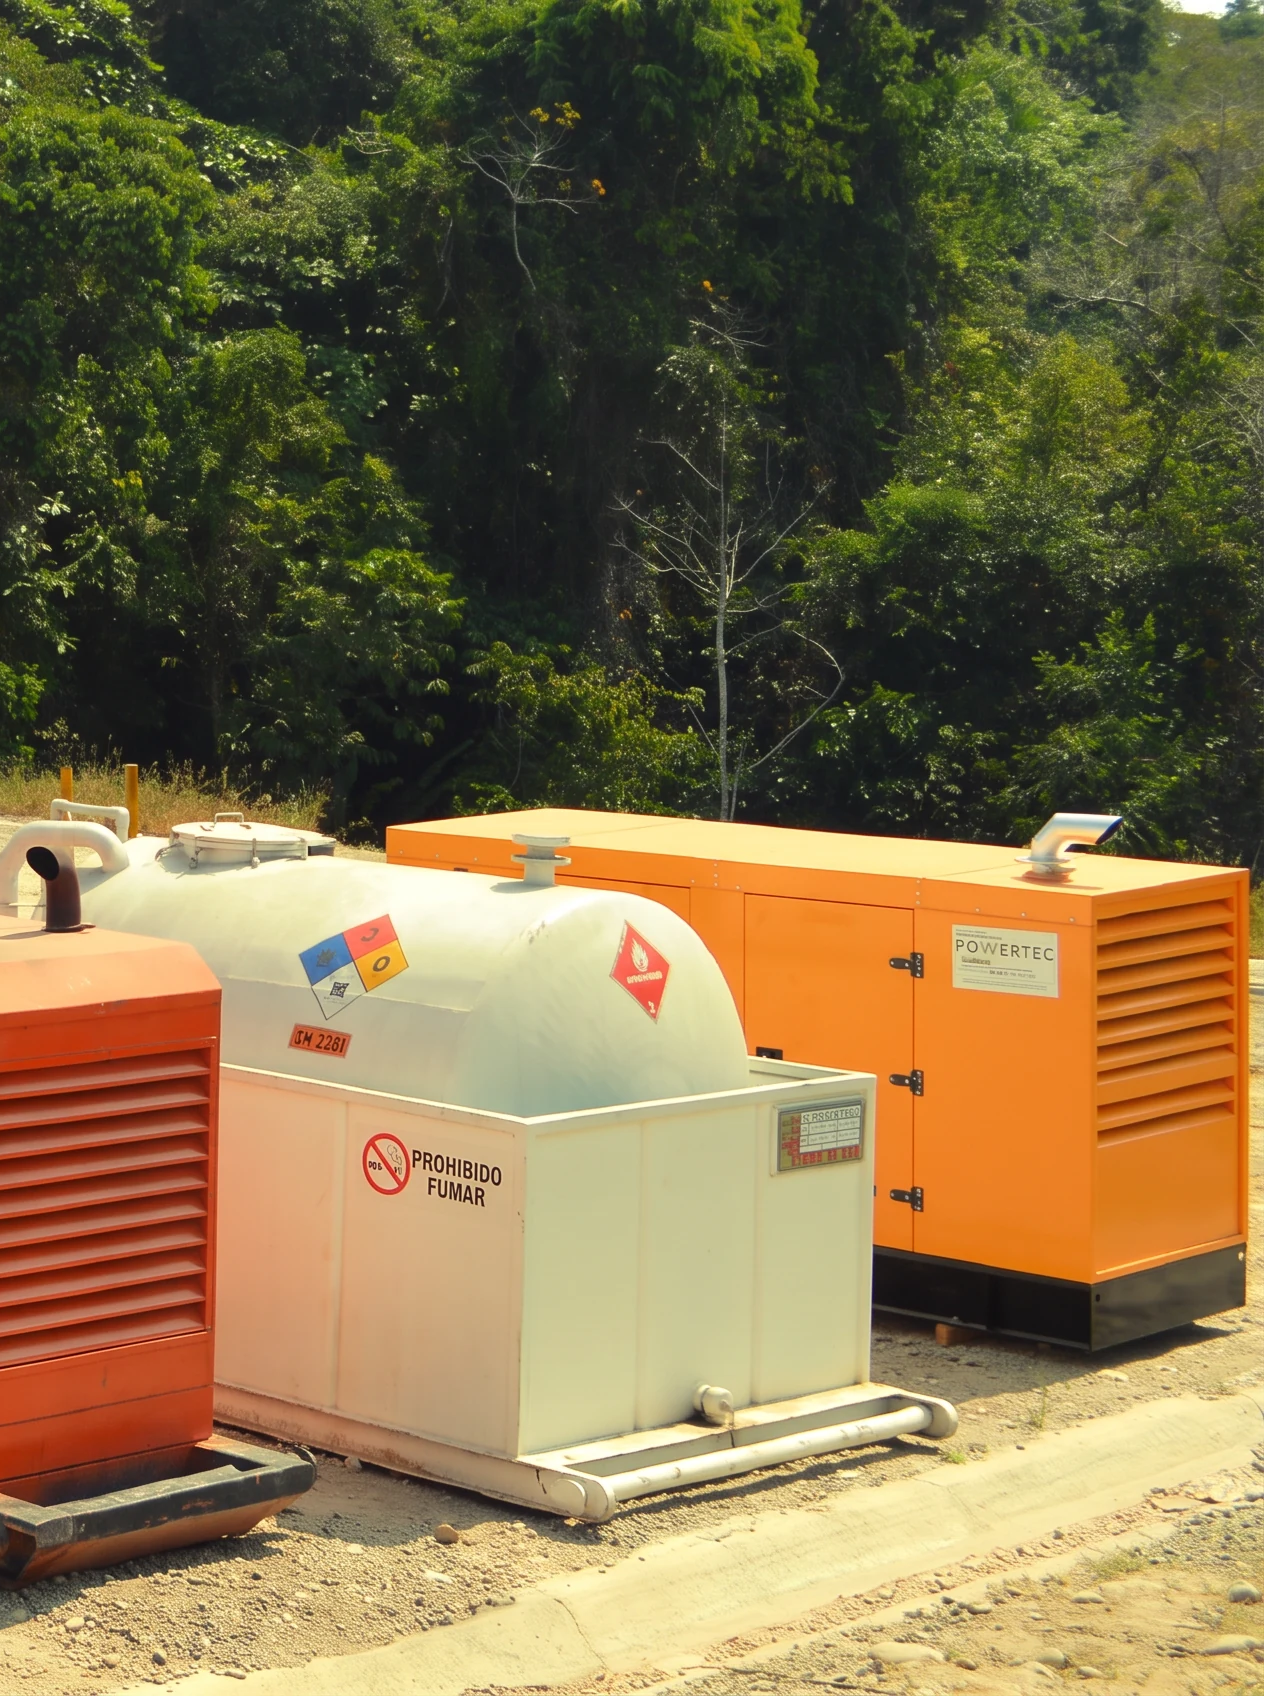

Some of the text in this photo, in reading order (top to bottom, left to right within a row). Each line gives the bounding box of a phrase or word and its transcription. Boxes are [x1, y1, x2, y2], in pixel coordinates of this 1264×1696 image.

[956, 939, 1054, 961] POWERTEC
[412, 1149, 502, 1186] PROHIBIDO
[428, 1177, 486, 1207] FUMAR
